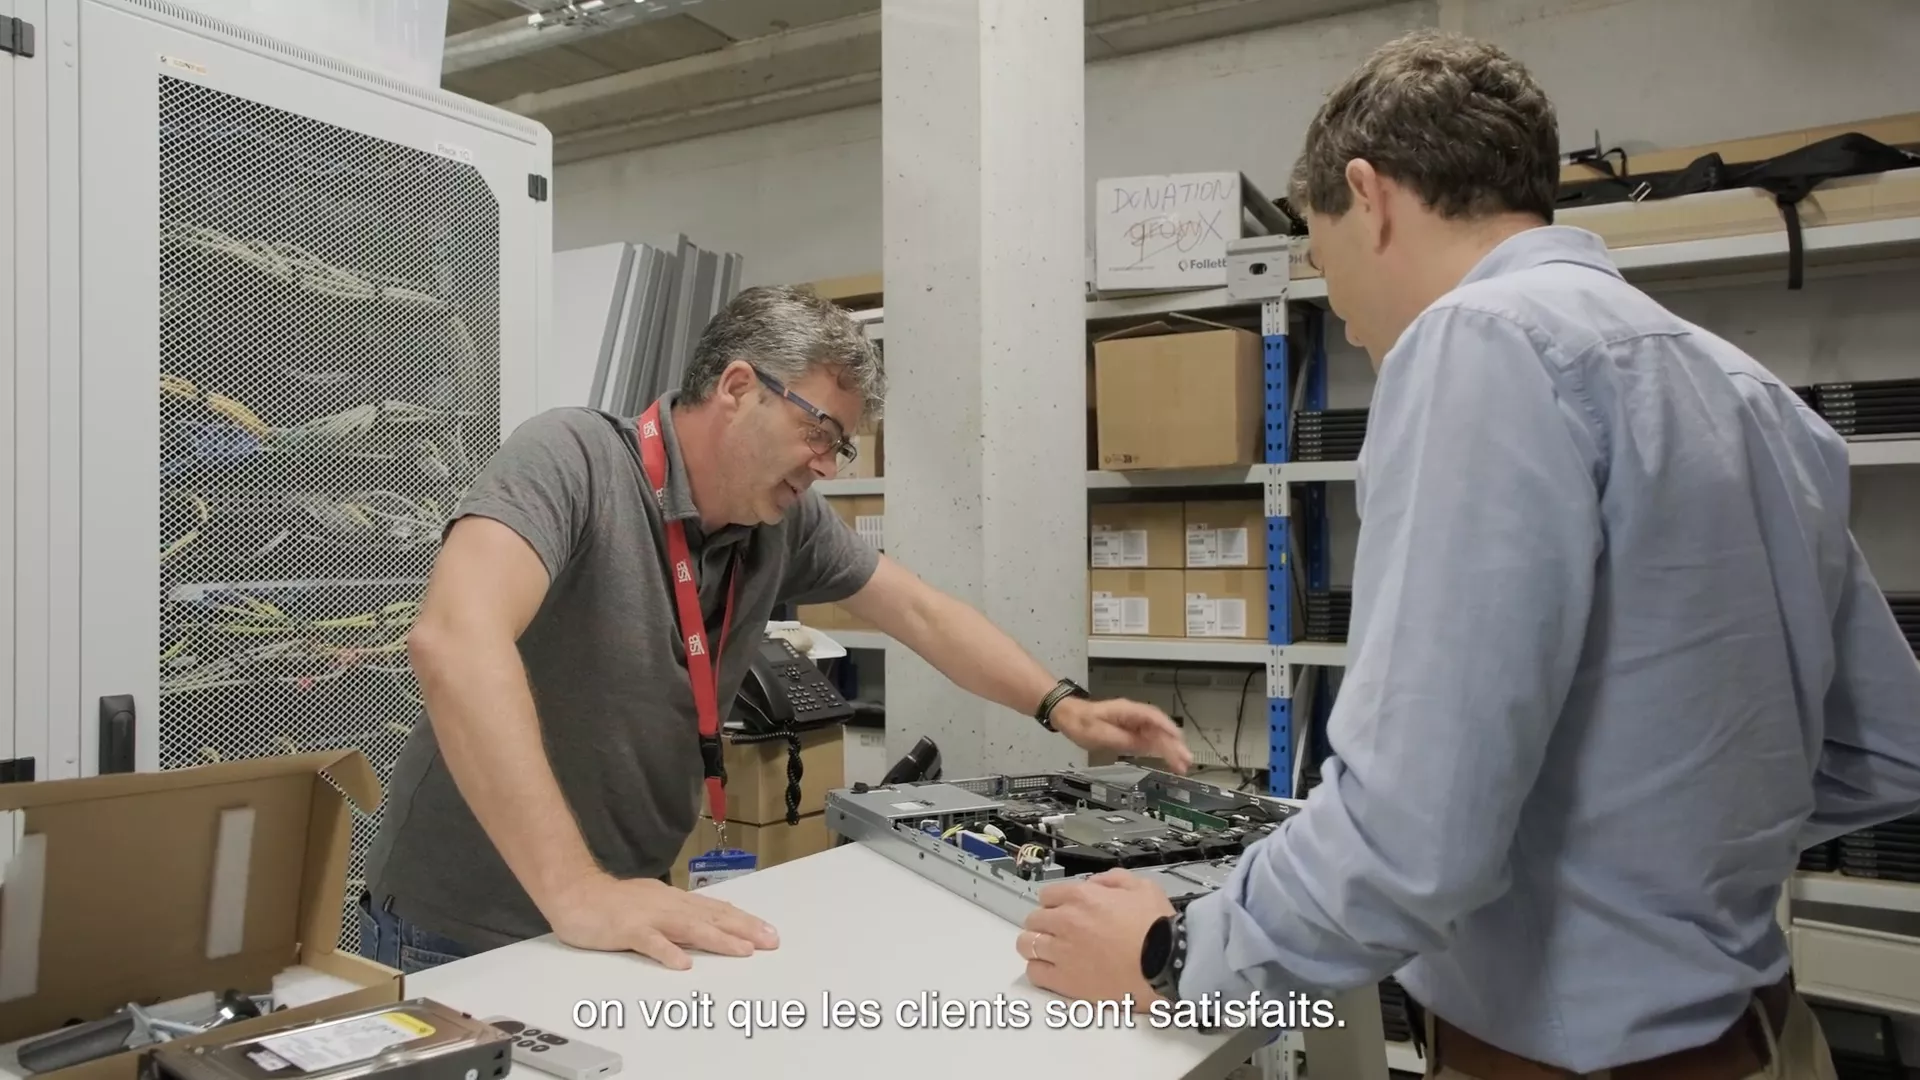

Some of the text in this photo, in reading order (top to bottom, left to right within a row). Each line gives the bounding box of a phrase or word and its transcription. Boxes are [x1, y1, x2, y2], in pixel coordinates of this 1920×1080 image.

[1112, 179, 1235, 214] DONATION
[1190, 257, 1227, 270] Follett
[676, 559, 692, 582] ISB
[688, 633, 705, 656] ISB
